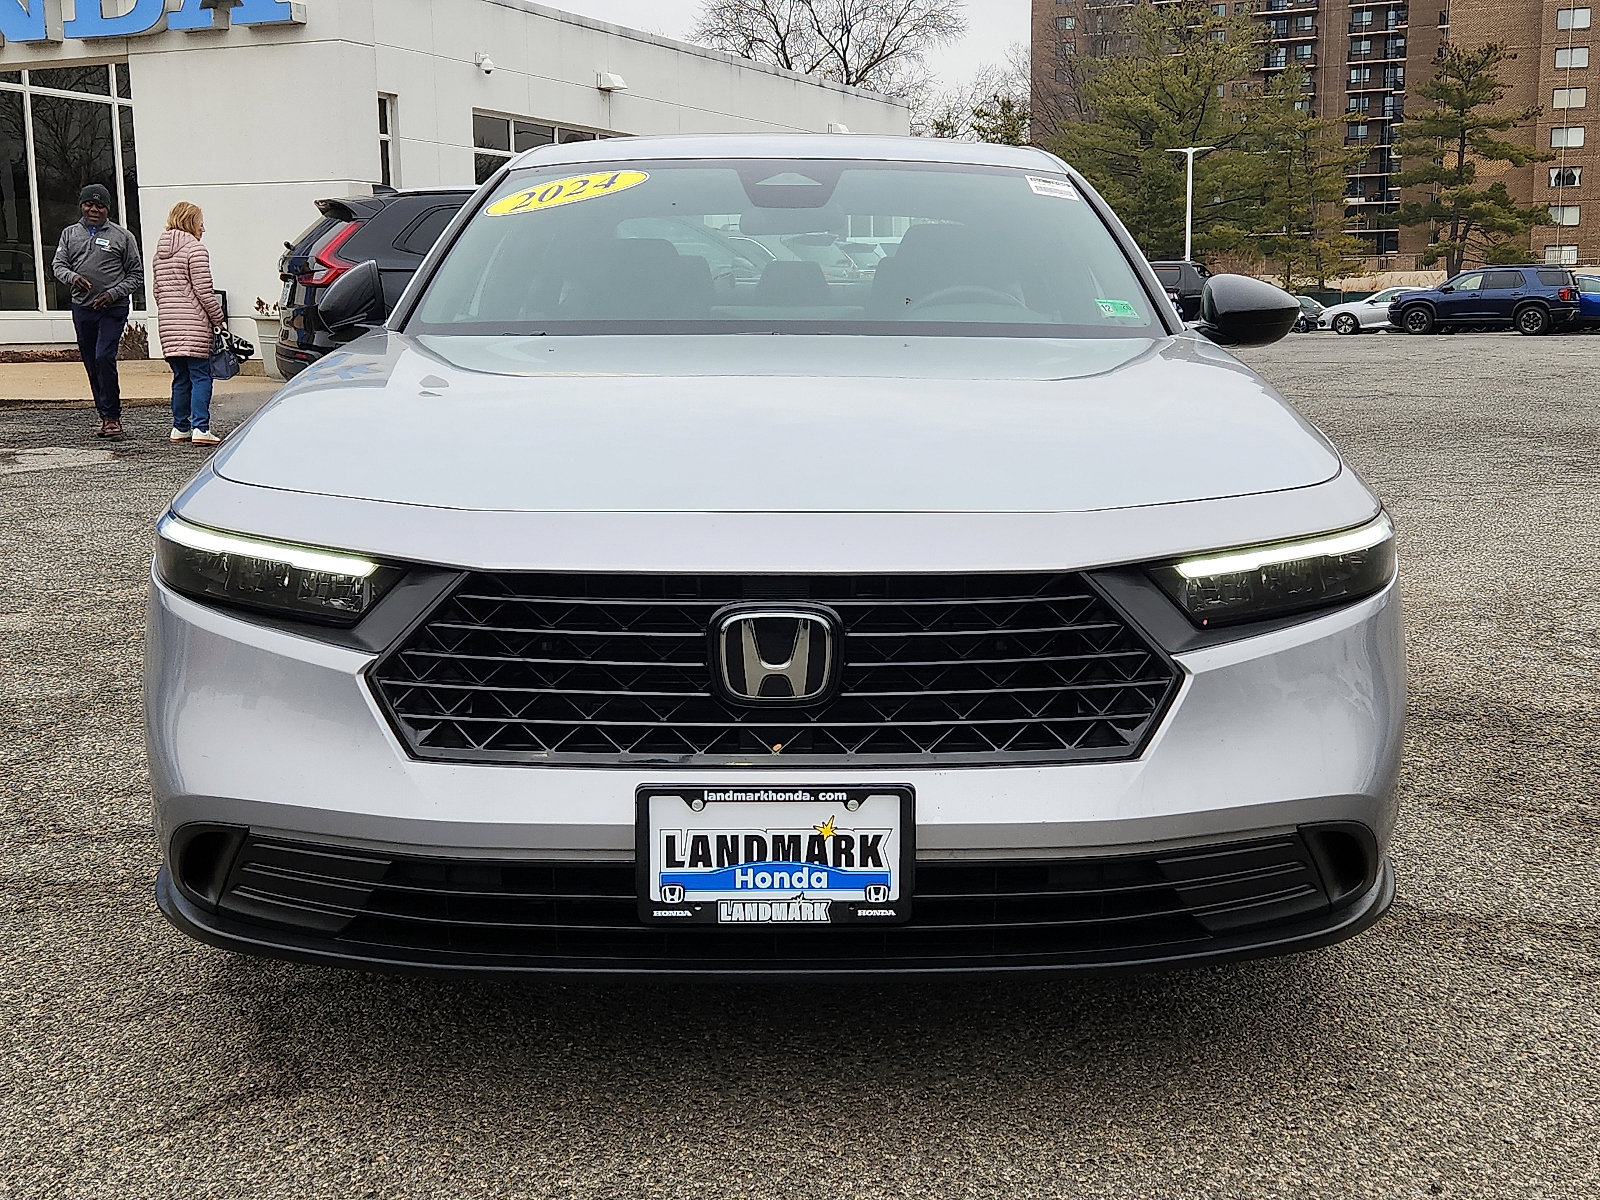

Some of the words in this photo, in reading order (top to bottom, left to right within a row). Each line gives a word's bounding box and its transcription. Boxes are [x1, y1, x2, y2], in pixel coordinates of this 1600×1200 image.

[509, 172, 621, 212] 2024
[665, 834, 884, 868] LANDMARK
[735, 867, 829, 889] Honda
[720, 902, 828, 921] LANDMARK
[857, 909, 896, 917] HONDA
